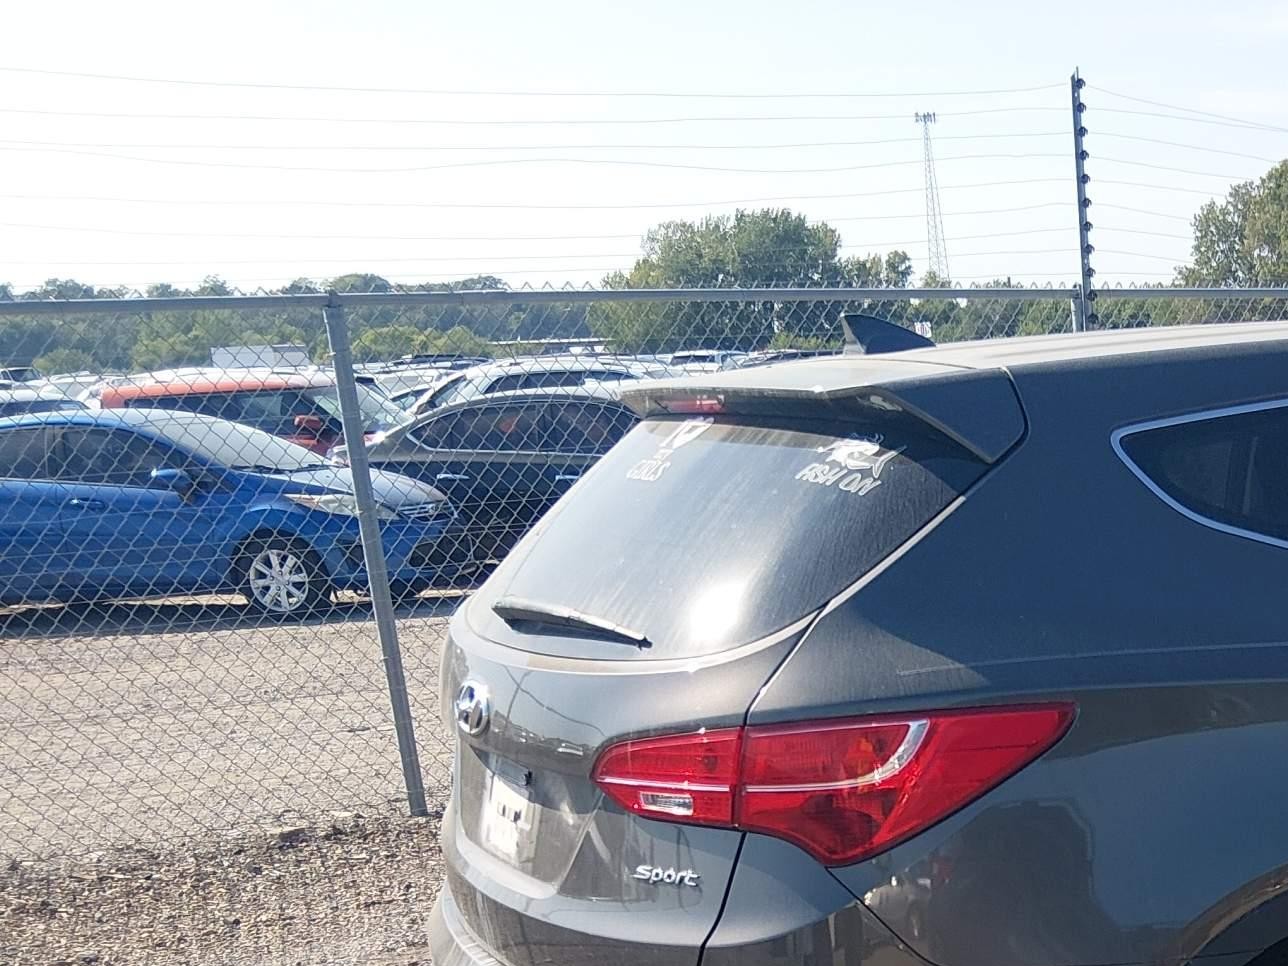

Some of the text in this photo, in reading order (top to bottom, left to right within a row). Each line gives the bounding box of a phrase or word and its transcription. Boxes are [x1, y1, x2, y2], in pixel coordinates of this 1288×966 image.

[794, 463, 882, 496] FISH ON
[632, 864, 699, 886] Sport
